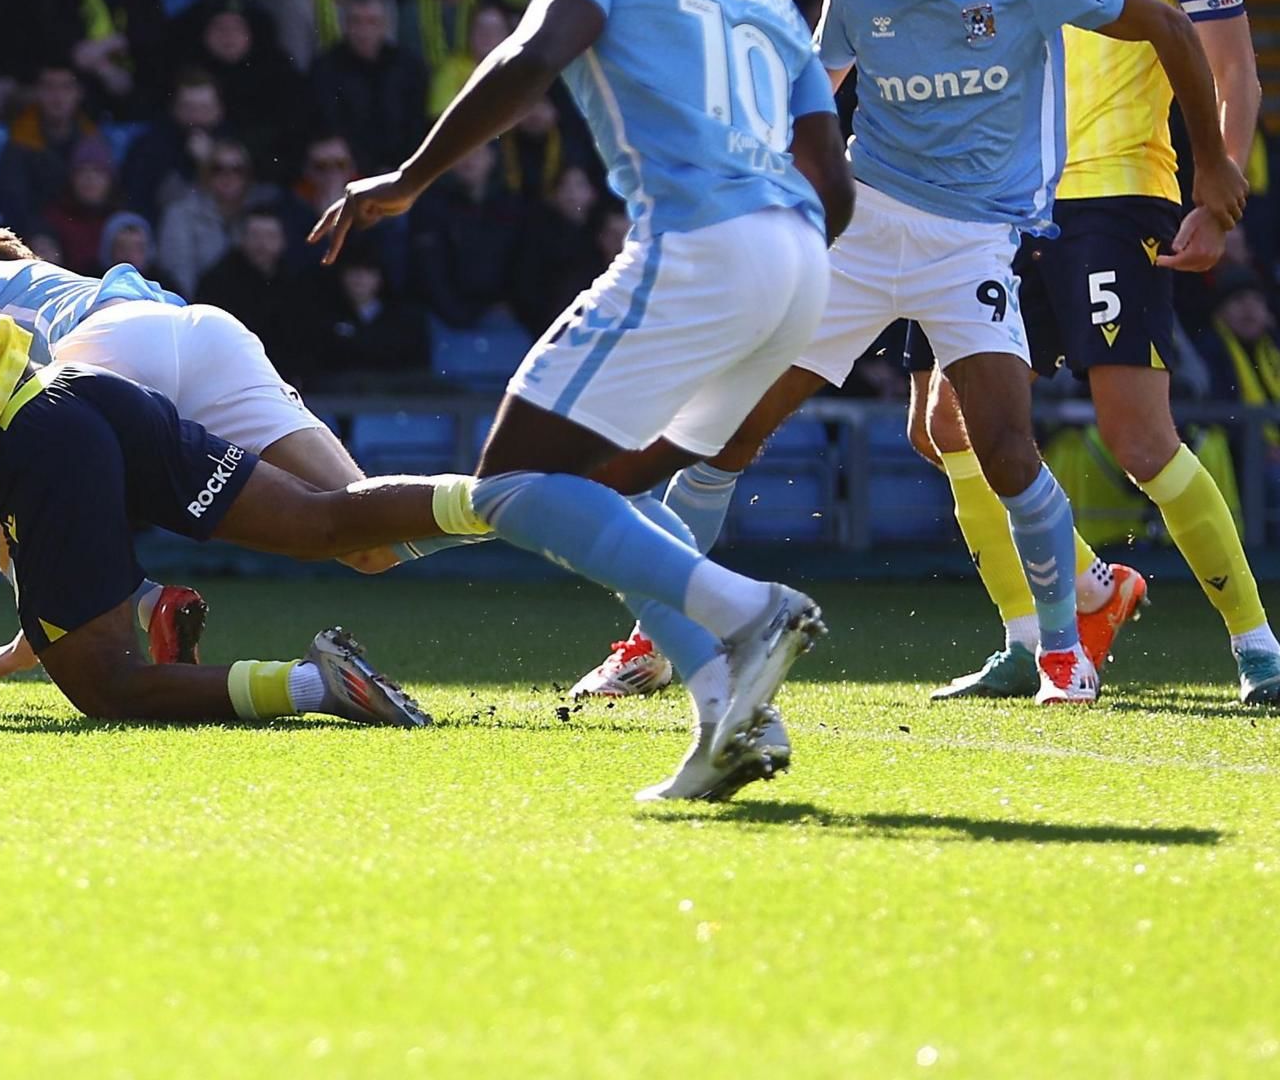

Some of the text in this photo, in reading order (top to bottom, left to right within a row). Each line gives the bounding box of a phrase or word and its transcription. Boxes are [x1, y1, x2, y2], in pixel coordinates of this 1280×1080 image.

[877, 65, 1009, 102] monzo
[975, 279, 1007, 323] 9
[1088, 270, 1122, 325] 5
